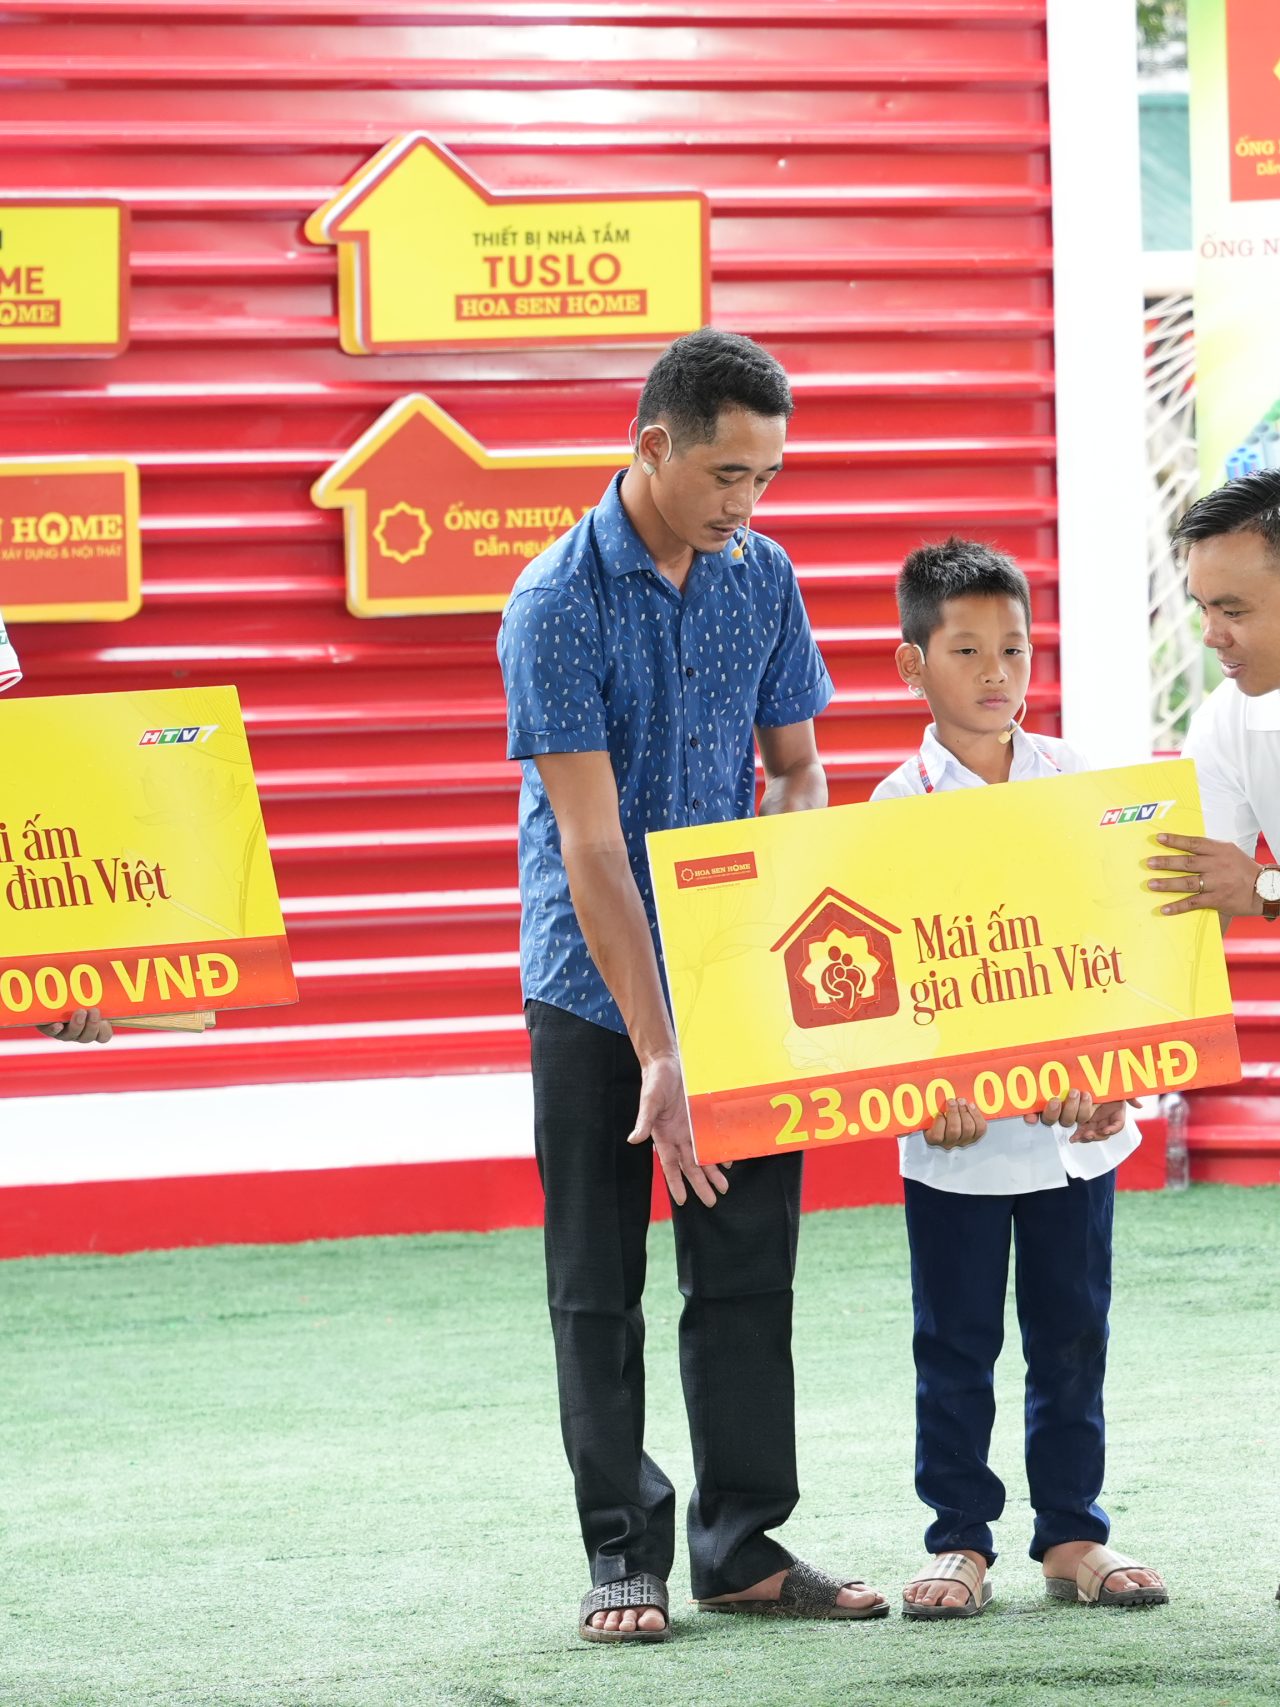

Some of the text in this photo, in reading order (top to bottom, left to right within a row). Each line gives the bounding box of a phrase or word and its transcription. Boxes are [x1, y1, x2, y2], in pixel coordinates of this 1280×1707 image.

[1235, 135, 1275, 157] ỐNG
[472, 226, 518, 247] THIẾT
[525, 231, 541, 249] BỊ
[549, 226, 586, 246] NHÀ
[1200, 231, 1254, 259] ỐNG
[483, 252, 621, 288] TUSLO
[461, 293, 641, 317] HOA SEN HOME
[12, 512, 123, 545] HOME
[444, 501, 499, 530] ỐNG
[505, 506, 576, 531] NHỰA
[474, 535, 510, 557] Dẫn
[138, 724, 220, 746] HTV7
[1100, 799, 1177, 826] HTV7
[22, 813, 82, 861] ấm
[6, 857, 171, 911] đình Việt
[694, 869, 711, 877] HOA
[711, 866, 726, 874] SEN
[727, 863, 751, 872] HOME
[911, 903, 1044, 964] Mái ấm
[110, 952, 239, 1003] VNĐ
[910, 943, 1127, 1026] gia đình Việt
[770, 1038, 1199, 1146] 23.000000 VNĐ
